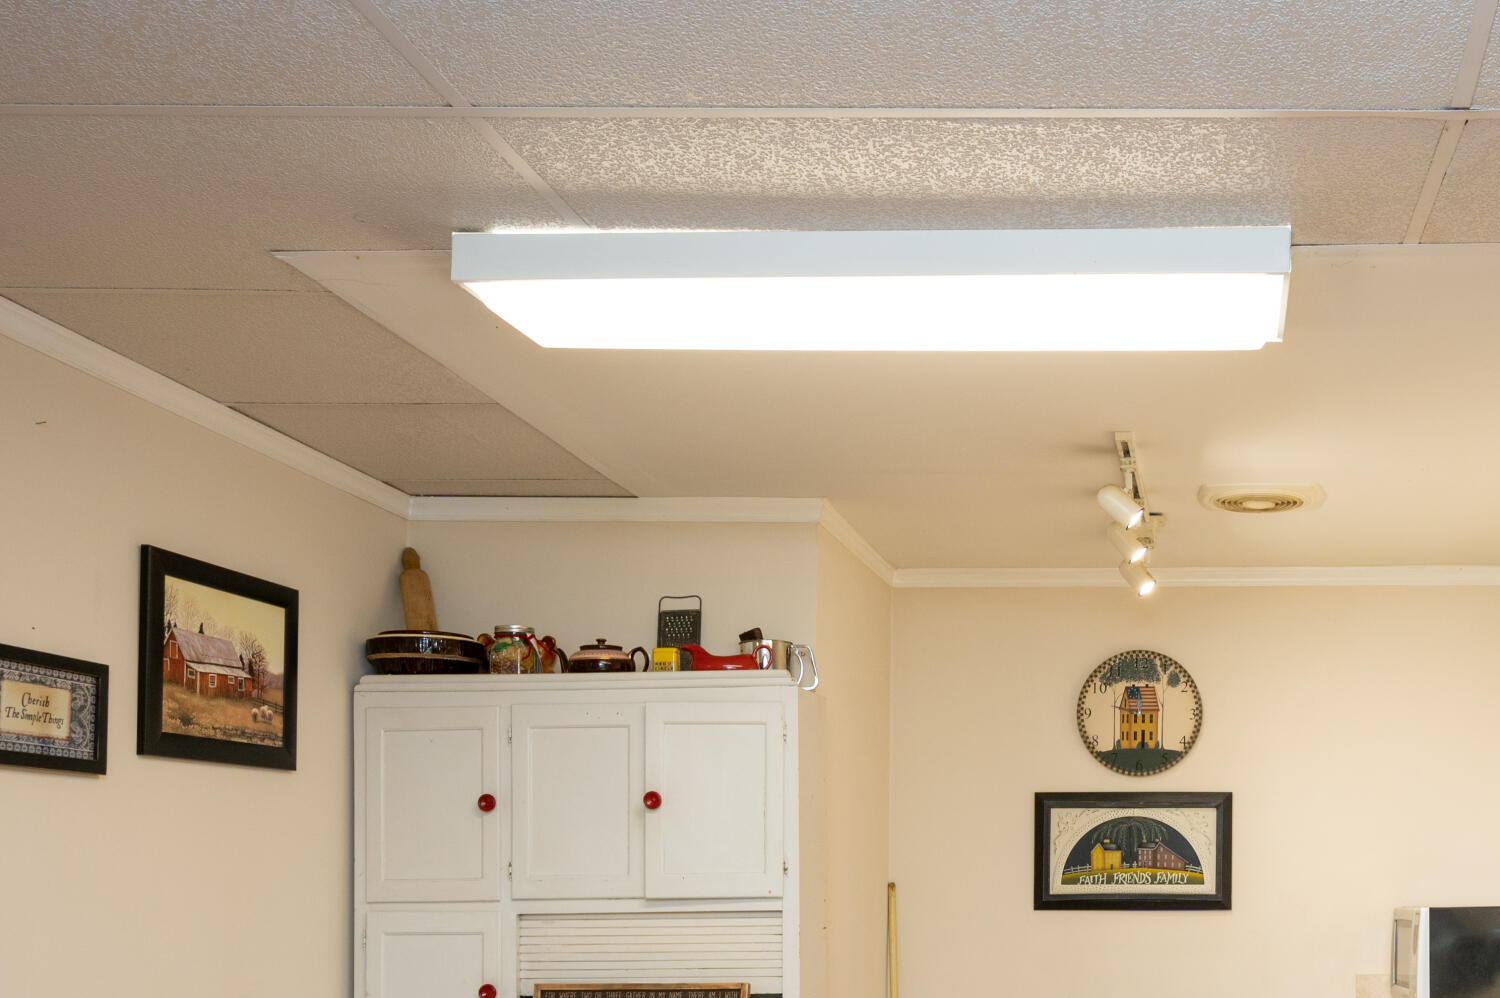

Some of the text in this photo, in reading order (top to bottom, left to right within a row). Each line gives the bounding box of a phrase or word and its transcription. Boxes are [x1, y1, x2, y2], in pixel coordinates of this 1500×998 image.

[22, 692, 50, 708] Cherish
[5, 706, 64, 729] The Simple Things
[1078, 871, 1188, 885] FAITH FRIENDS FAMILY
